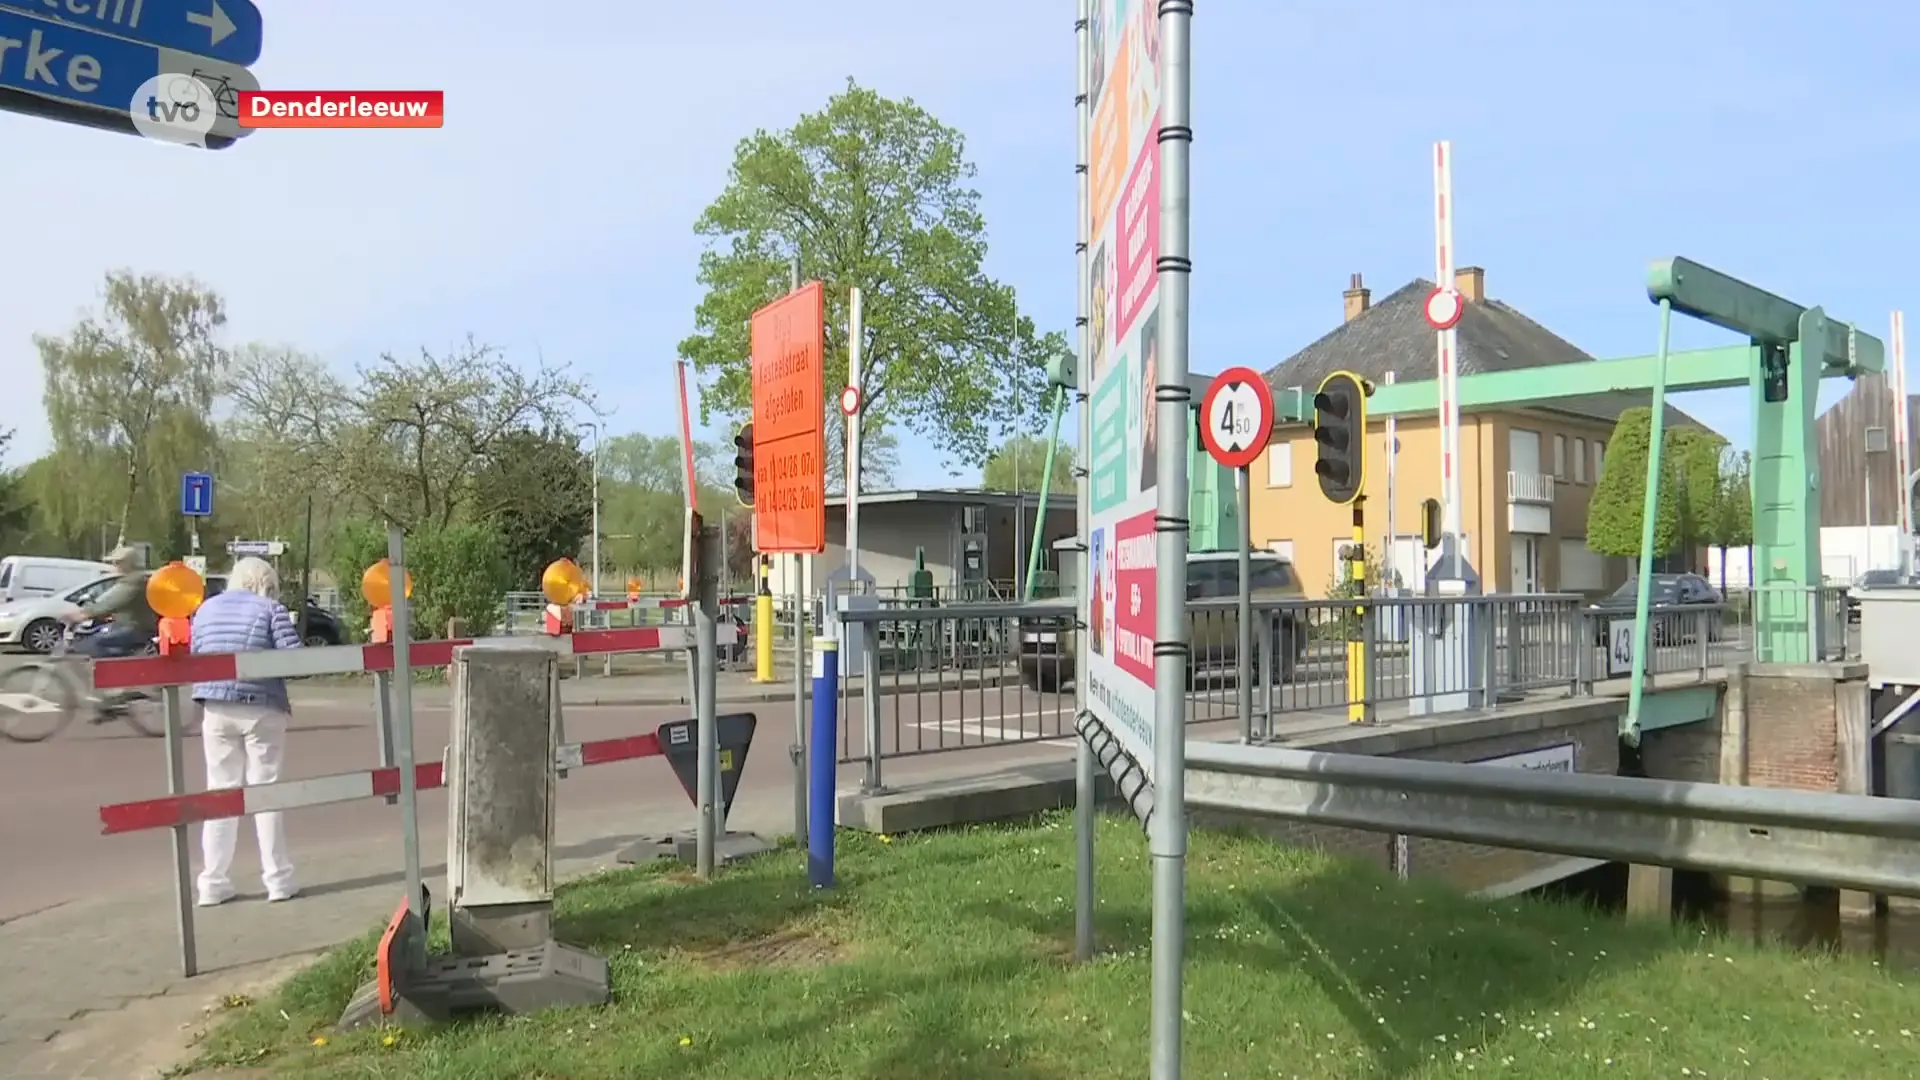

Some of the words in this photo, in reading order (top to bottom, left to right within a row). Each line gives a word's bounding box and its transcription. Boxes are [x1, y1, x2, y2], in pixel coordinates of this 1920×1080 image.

[764, 386, 804, 424] afgesloten
[1220, 399, 1234, 436] 4
[1236, 417, 1250, 434] 50
